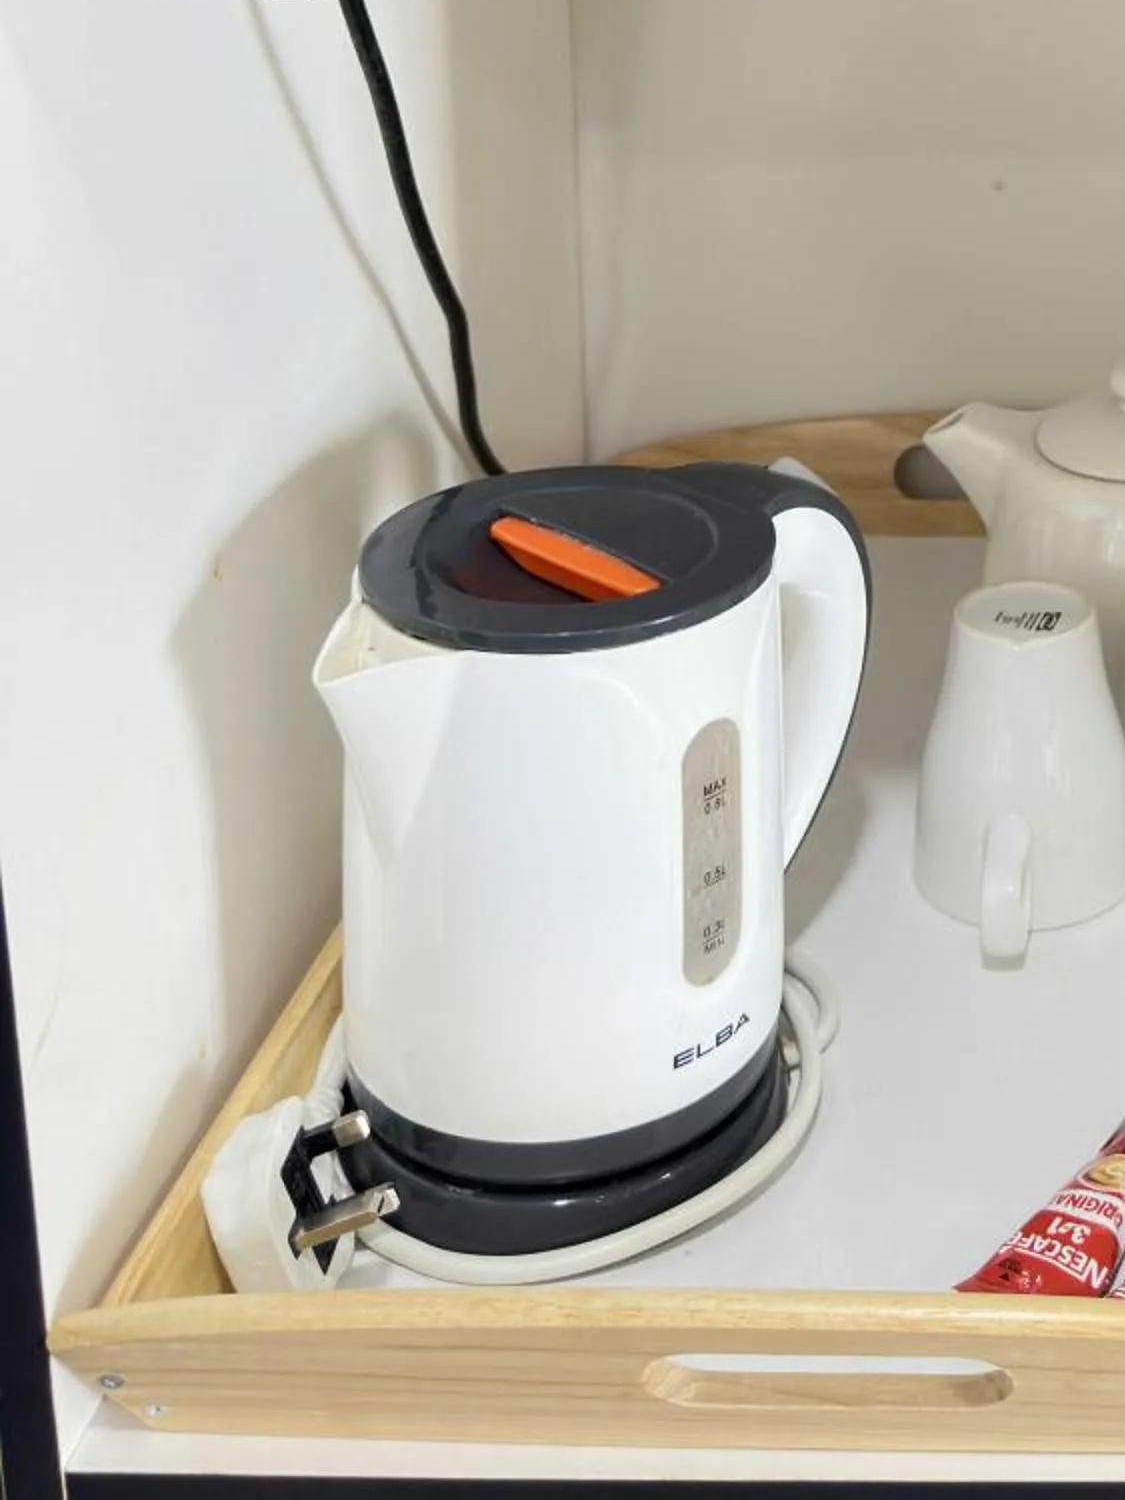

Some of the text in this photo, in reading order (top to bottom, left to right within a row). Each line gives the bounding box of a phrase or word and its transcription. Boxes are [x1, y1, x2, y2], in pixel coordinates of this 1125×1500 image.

[703, 776, 727, 796] MAX
[673, 1011, 751, 1070] ELBA
[1055, 1192, 1123, 1227] ORIGINA
